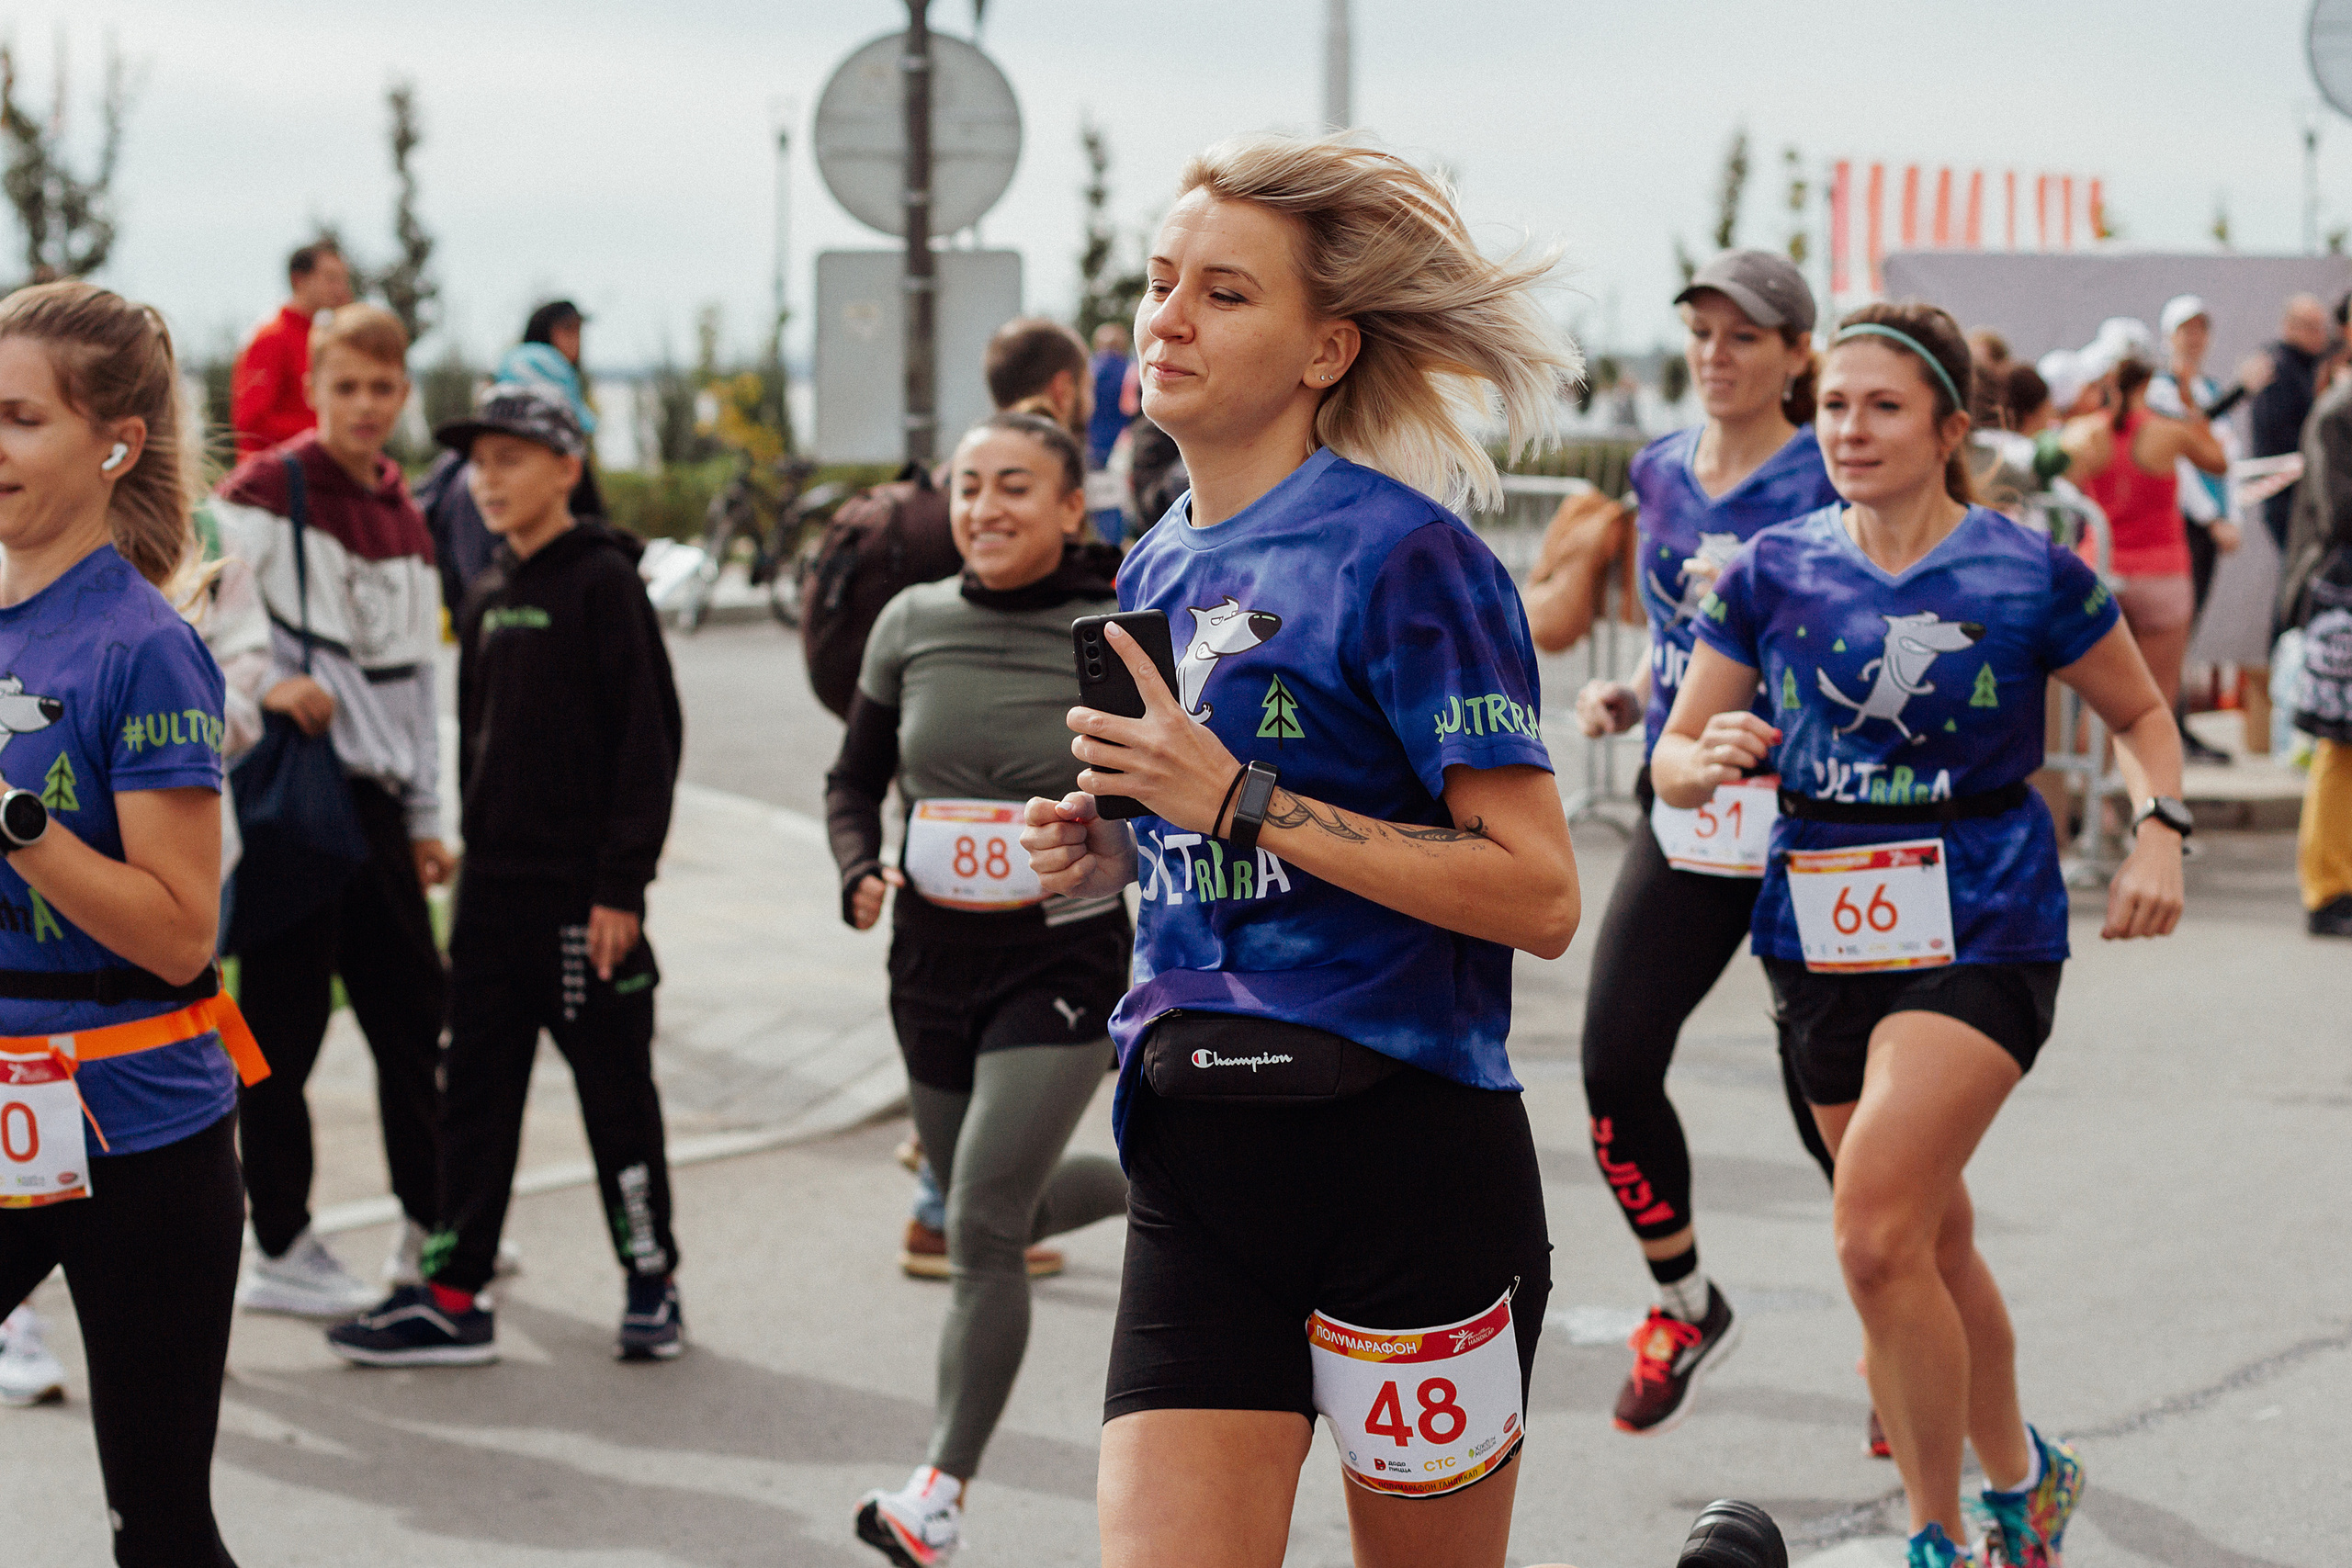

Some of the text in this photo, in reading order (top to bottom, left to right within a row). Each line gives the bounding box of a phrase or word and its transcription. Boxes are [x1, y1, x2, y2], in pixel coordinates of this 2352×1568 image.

[1695, 797, 1742, 840] 51
[954, 836, 1010, 879] 88
[1833, 883, 1898, 935] 66
[1192, 1049, 1293, 1073] Champion
[1316, 1325, 1418, 1355] ПОЛУМАРАФОН
[1364, 1378, 1467, 1447] 48
[1378, 1469, 1478, 1493] ПОЛУМАРАФОН ГАНДИКАП
[1424, 1456, 1456, 1472] СТС
